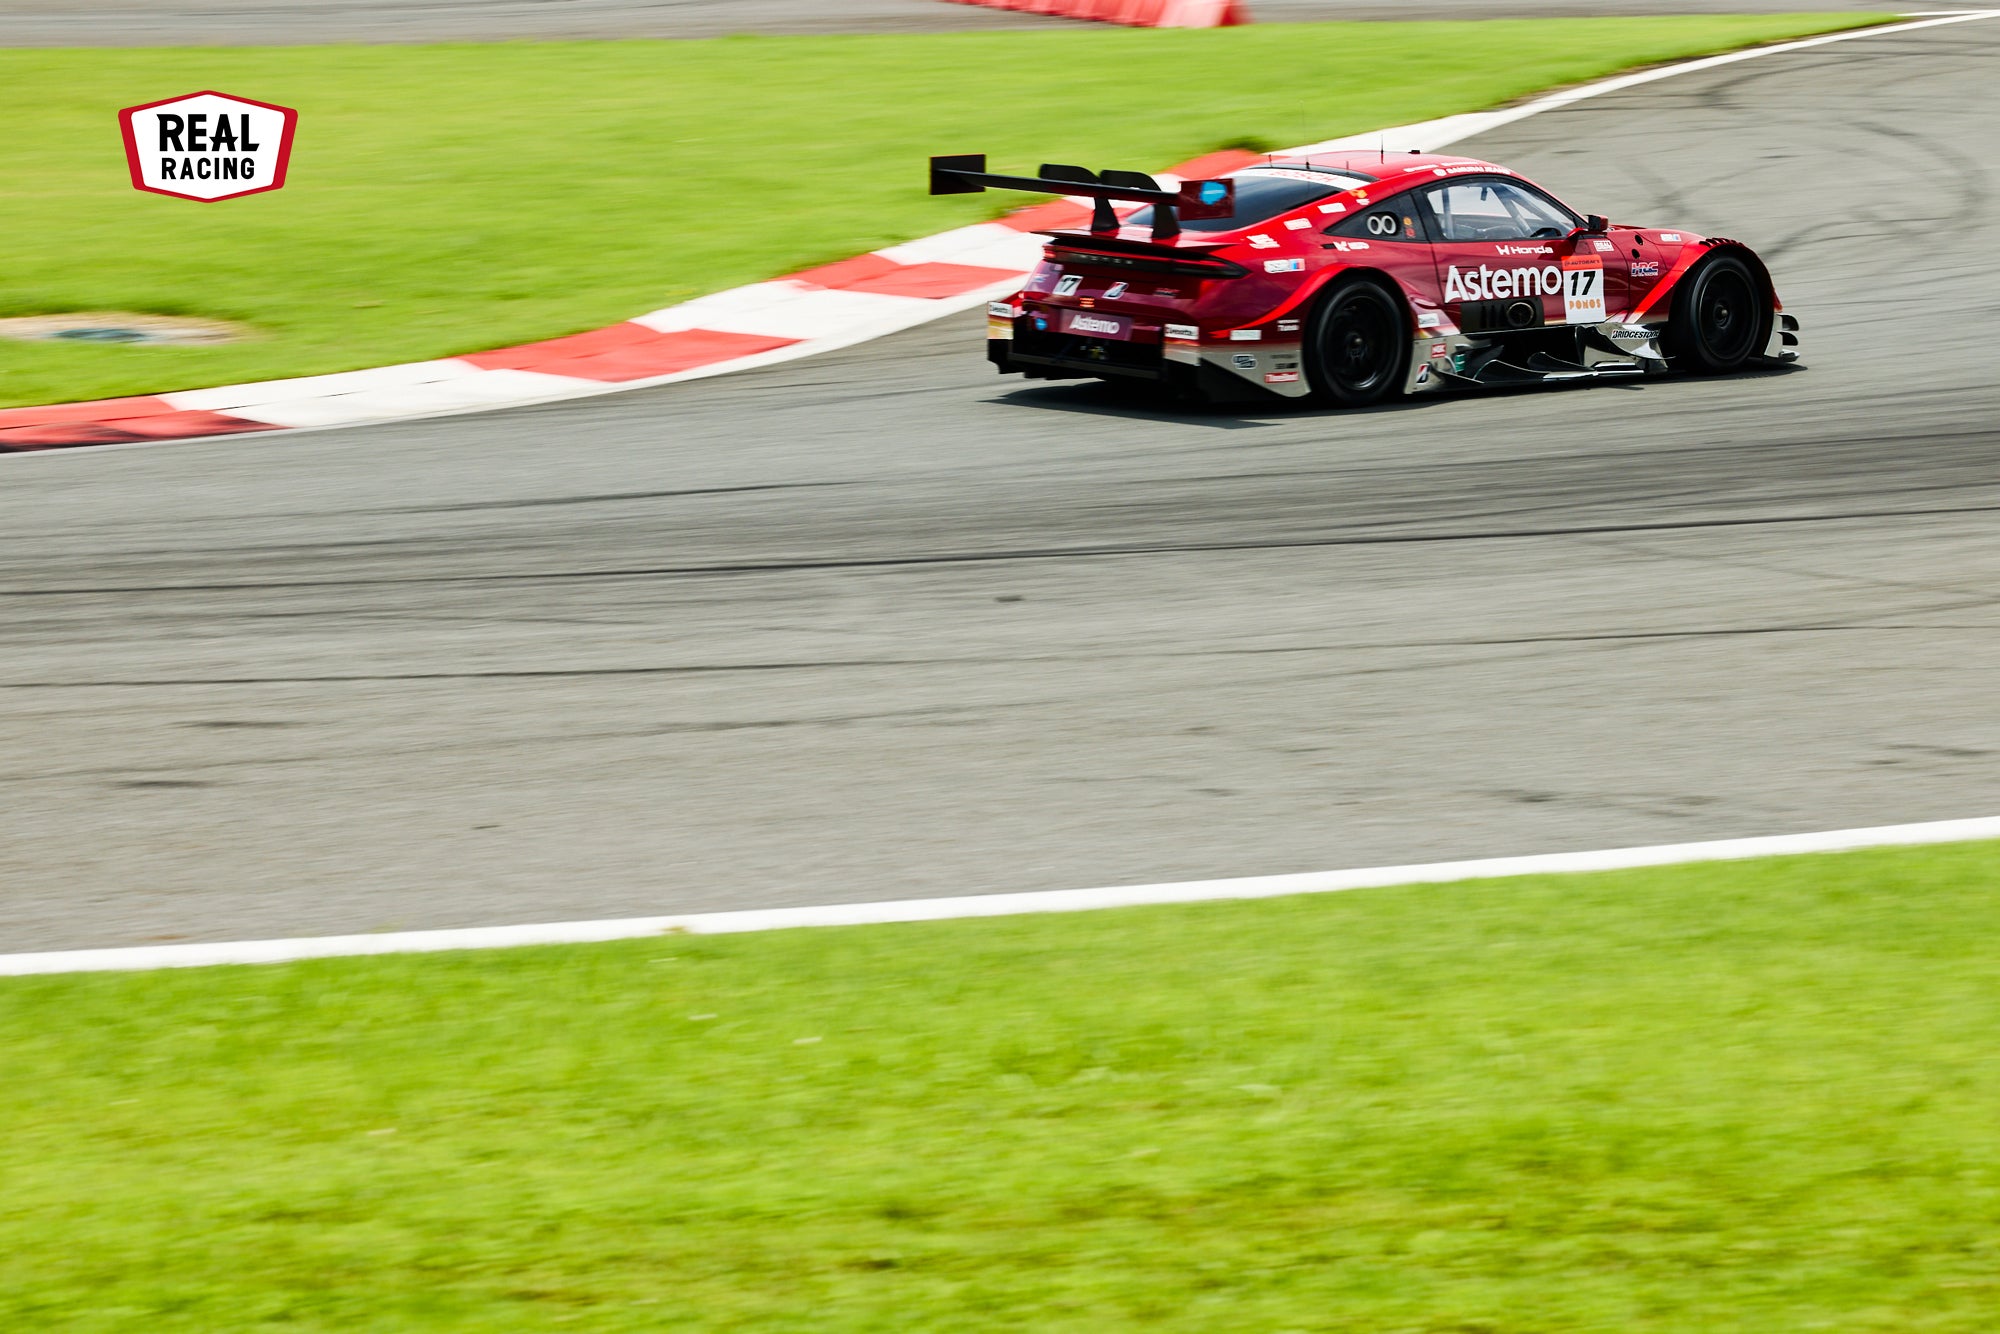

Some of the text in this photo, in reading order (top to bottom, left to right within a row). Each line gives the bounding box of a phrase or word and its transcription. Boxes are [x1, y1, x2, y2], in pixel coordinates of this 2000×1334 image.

[1511, 245, 1554, 254] Honda
[1631, 261, 1659, 275] HRC
[1444, 263, 1562, 303] Astemo
[1570, 270, 1596, 297] 17
[1569, 298, 1601, 310] PONOS
[1069, 314, 1120, 335] Astemo
